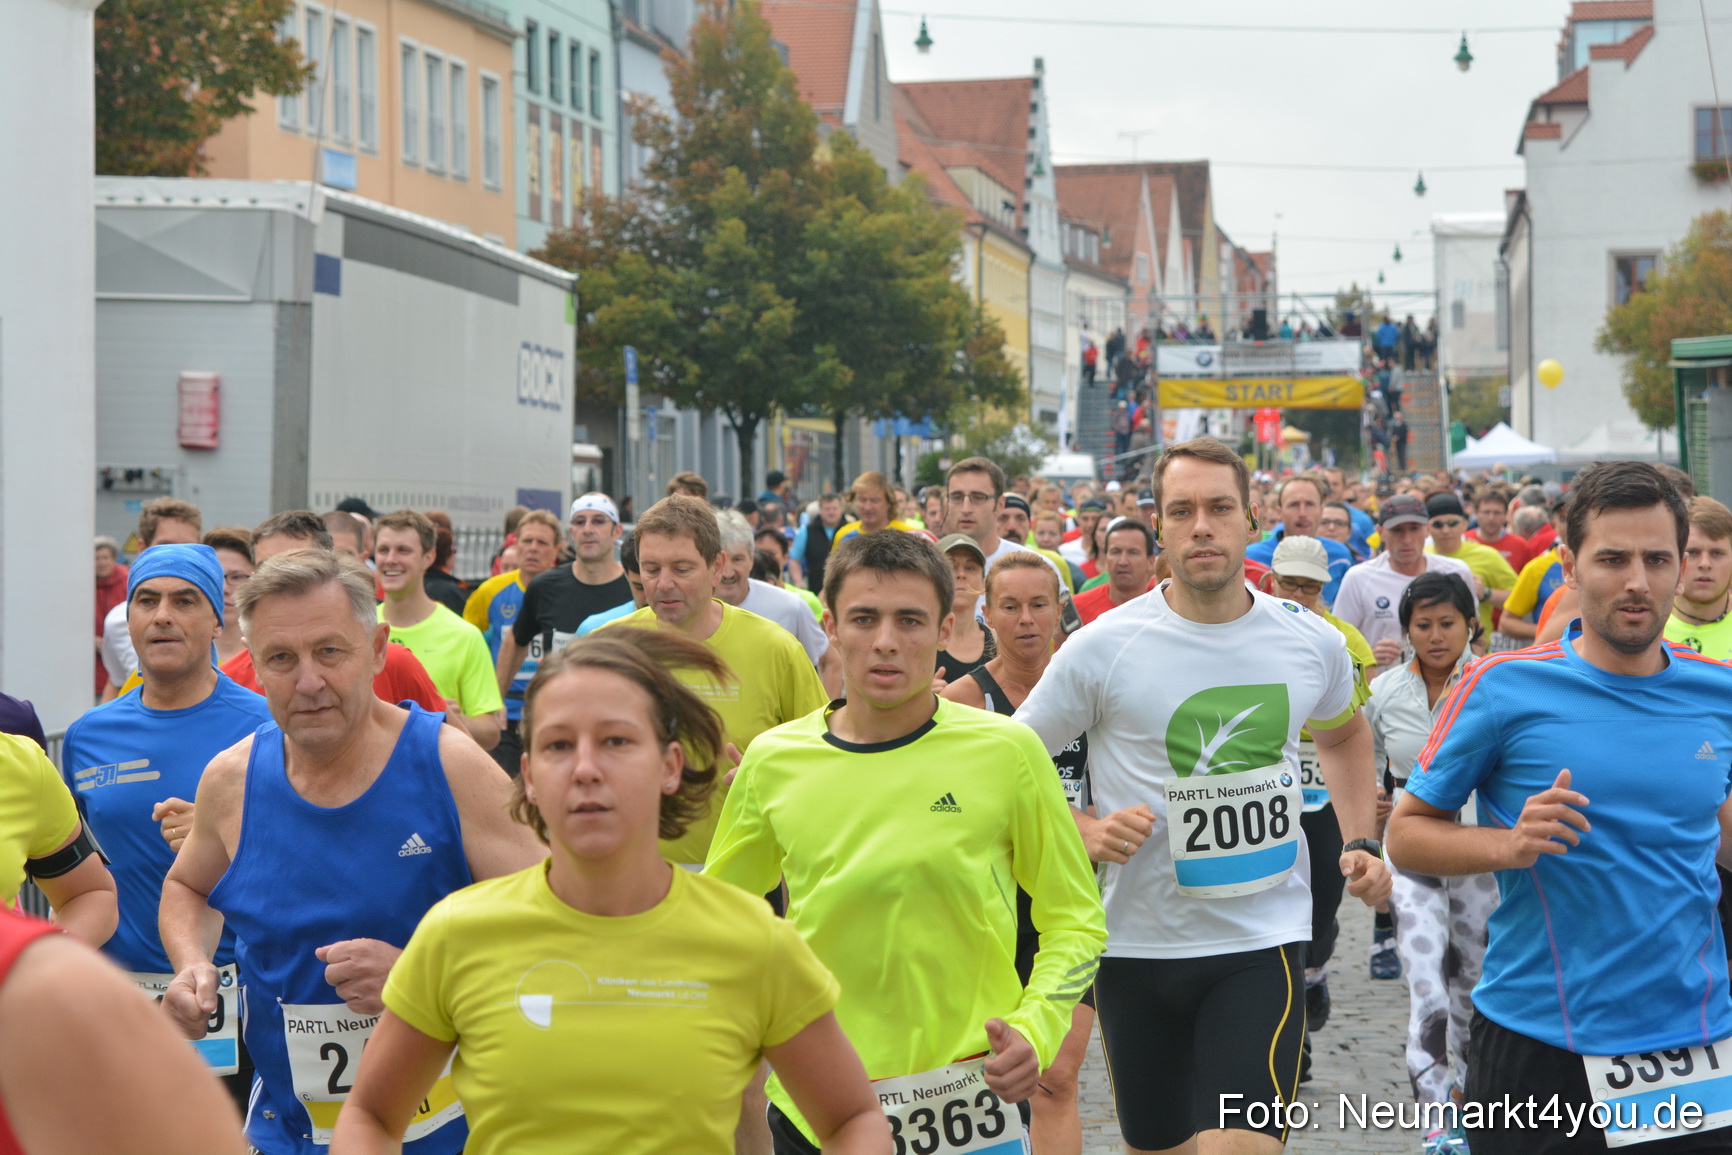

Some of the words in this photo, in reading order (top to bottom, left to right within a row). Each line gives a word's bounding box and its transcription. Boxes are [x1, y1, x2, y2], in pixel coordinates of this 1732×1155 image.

[1225, 383, 1296, 402] START
[1169, 789, 1214, 802] PARTL
[1217, 779, 1278, 798] Neumarkt
[929, 804, 962, 813] adidas
[1183, 795, 1290, 852] 2008
[398, 846, 432, 857] adidas
[288, 1019, 335, 1034] PARTL
[336, 1015, 381, 1033] Neum
[879, 1092, 910, 1106] RTL
[912, 1073, 980, 1101] Neumarkt
